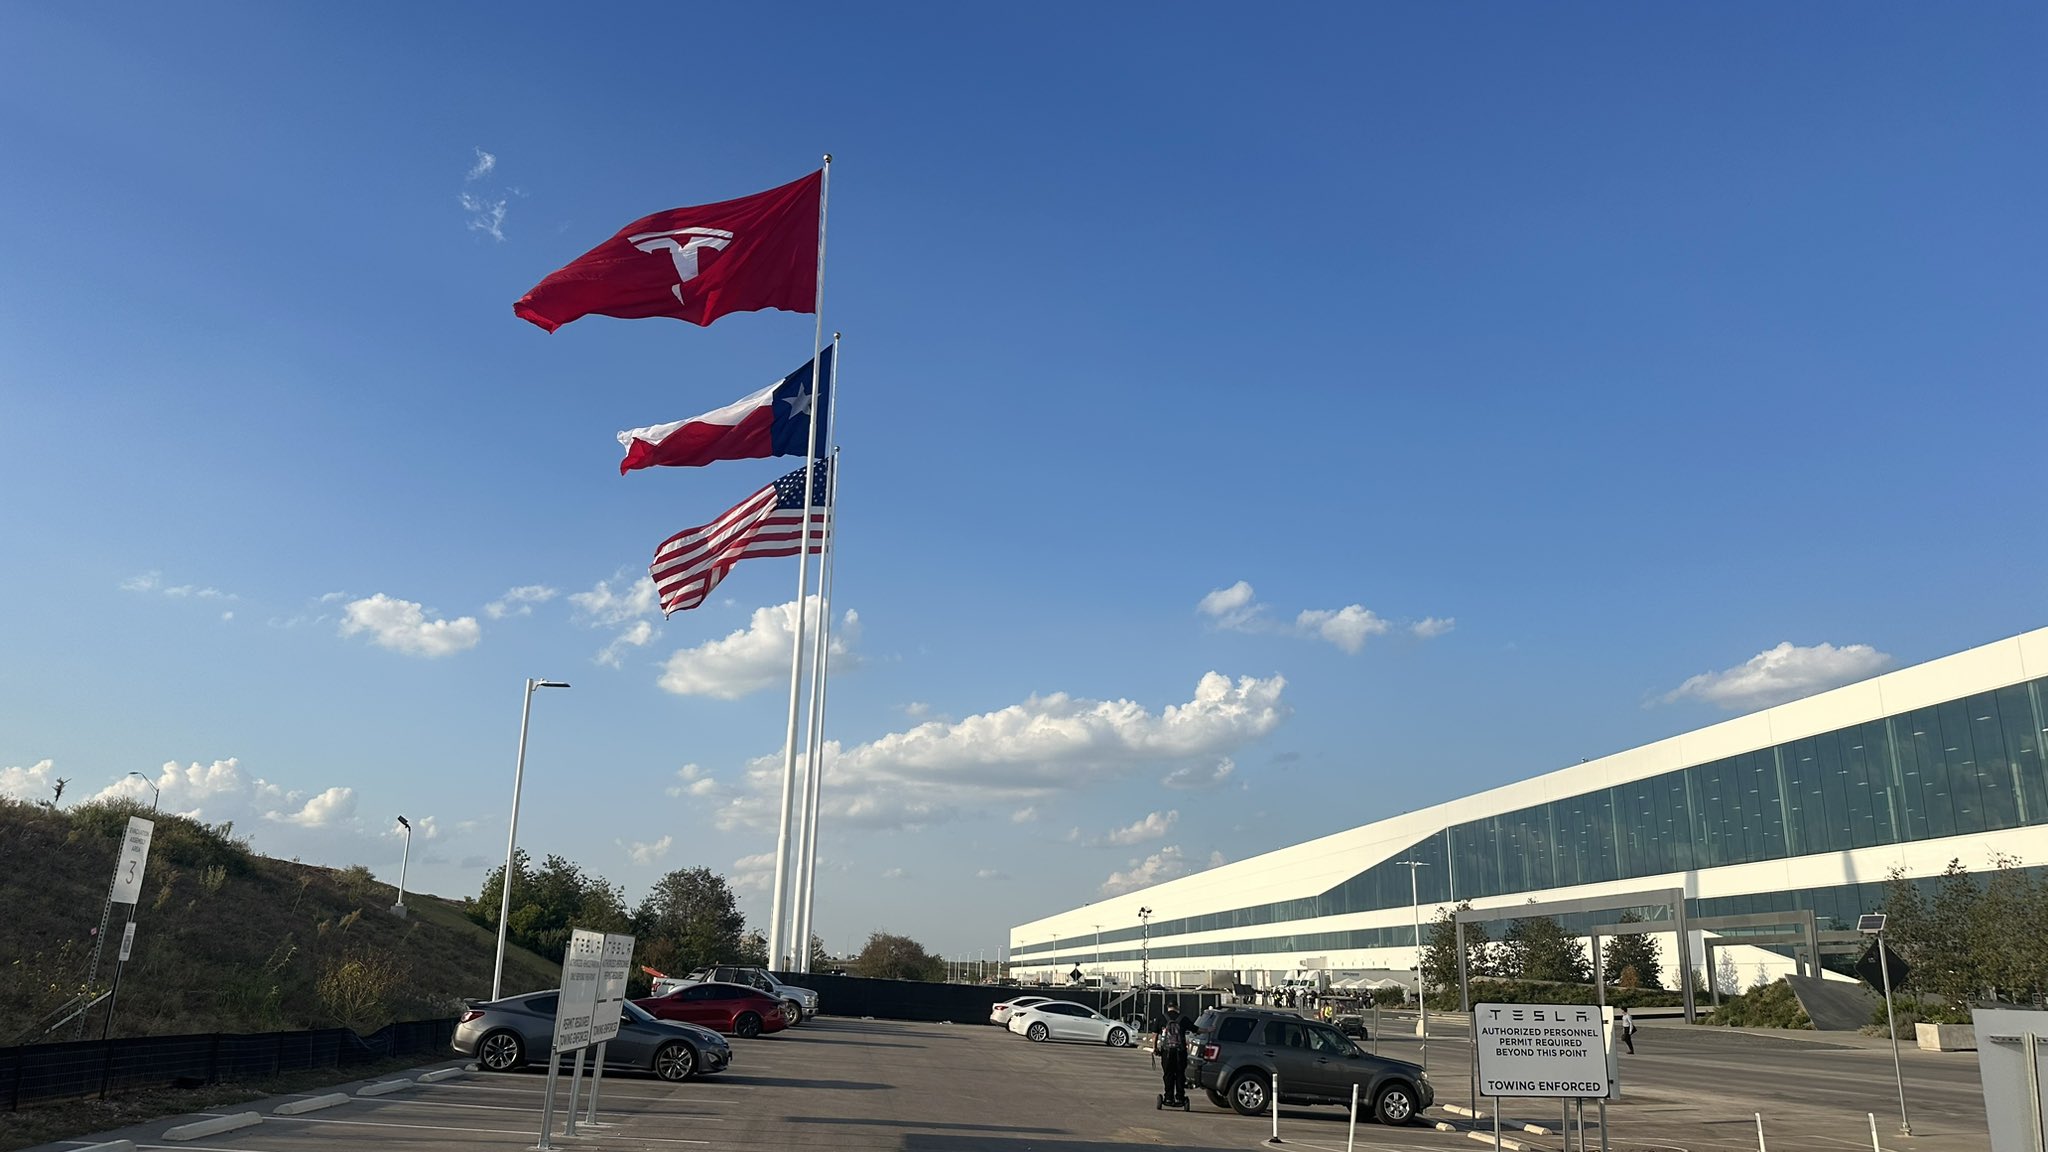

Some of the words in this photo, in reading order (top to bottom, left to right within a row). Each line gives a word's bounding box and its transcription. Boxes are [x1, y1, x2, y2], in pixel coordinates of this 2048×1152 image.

[126, 860, 137, 884] 3
[1489, 1009, 1588, 1022] TESLA
[1481, 1027, 1541, 1036] AUTHORIZED
[1544, 1028, 1599, 1037] PERSONNEL
[1500, 1038, 1533, 1046] PERMIT
[1536, 1039, 1582, 1047] REQUIRED
[1496, 1048, 1534, 1057] BEYOND
[1537, 1049, 1558, 1057] THIS
[1560, 1049, 1588, 1057] POINT
[1488, 1080, 1536, 1090] TOWING
[1539, 1081, 1601, 1091] ENFORCED
